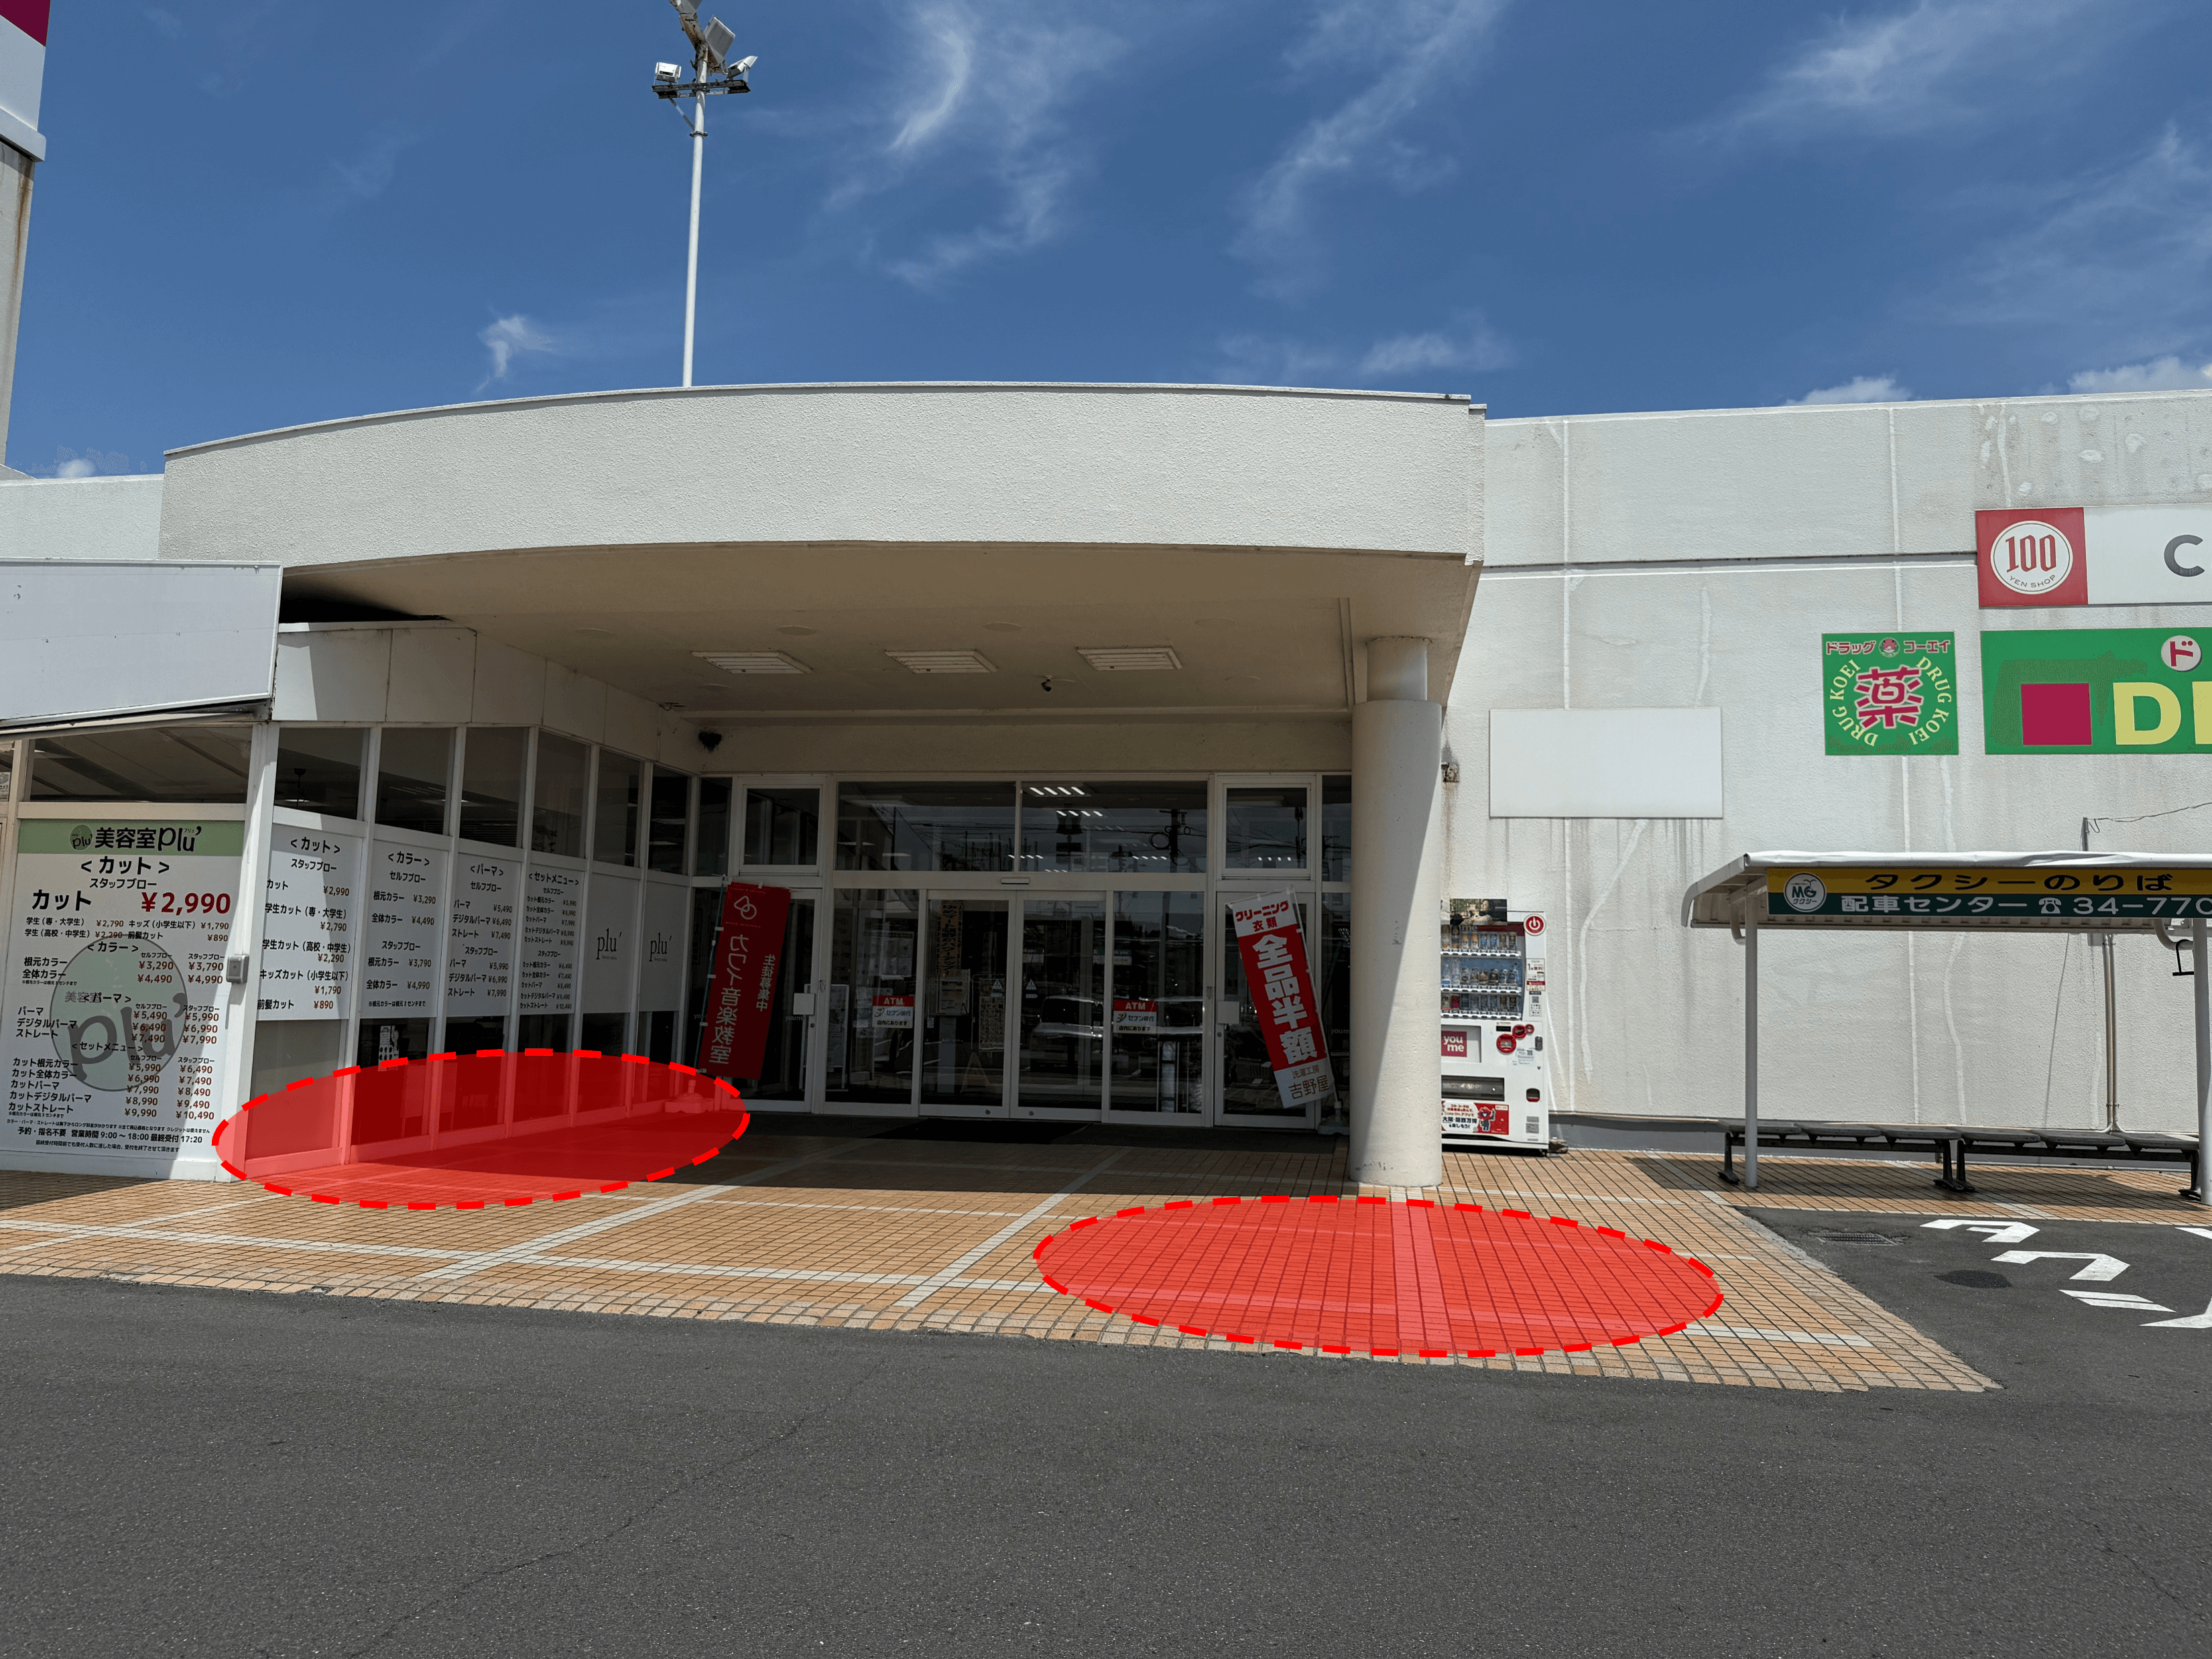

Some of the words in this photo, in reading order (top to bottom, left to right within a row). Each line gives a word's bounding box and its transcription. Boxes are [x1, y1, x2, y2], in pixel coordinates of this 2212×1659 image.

[2006, 534, 2056, 572] 100
[2164, 535, 2205, 577] C
[2010, 575, 2027, 587] YEN
[2031, 574, 2055, 588] SHOP
[1827, 641, 1876, 654] ドラッグ
[1904, 640, 1950, 653] コーエイ
[1830, 660, 1861, 700] KOEI
[1916, 656, 1952, 703] DRUG
[1854, 664, 1924, 729] 薬
[2113, 681, 2212, 745] D
[1833, 706, 1878, 746] DRUG
[1908, 709, 1949, 745] KOEI
[291, 859, 336, 872] スタッフブロー
[89, 878, 157, 889] スタッフブロー
[390, 871, 426, 883] セルフブロー
[1865, 873, 2173, 891] タクシーのりば
[267, 879, 288, 890] カット
[323, 885, 349, 896] ¥2,990
[471, 881, 501, 892] セルフブロー
[32, 889, 92, 911] カット
[141, 892, 231, 915] ¥2,990
[373, 891, 404, 902] 根元カラー
[414, 895, 436, 904] ¥3,290
[1841, 895, 2028, 913] 配車センター
[454, 900, 471, 909] パーマ
[493, 904, 512, 913] ¥5,490
[1235, 901, 1289, 922] クリーニング
[96, 920, 124, 928] ¥2,790
[201, 922, 229, 930] ¥1,790
[320, 922, 347, 931] ¥2,790
[372, 913, 403, 924] 全体カラー
[412, 916, 434, 926] ¥4,490
[452, 914, 491, 924] デジタルパーマ
[492, 917, 511, 926] ¥6,490
[1253, 917, 1278, 931] 衣類
[95, 930, 123, 939] ¥2,290
[127, 931, 164, 940] 前髪カット
[452, 929, 479, 938] ストレート
[491, 931, 511, 939] ¥7,490
[382, 941, 420, 950] スタッフブロー
[465, 946, 498, 956] スタッフブロー
[24, 957, 68, 967] 根元カラー
[139, 961, 174, 970] ¥3,290
[188, 963, 224, 971] ¥3,790
[318, 954, 344, 963] ¥2,290
[368, 957, 399, 967] 根元カラー
[409, 959, 432, 967] ¥3,790
[450, 959, 467, 968] パーマ
[489, 962, 509, 970] ¥5,990
[22, 969, 66, 979] 全体カラー
[137, 974, 172, 983] ¥4,490
[188, 975, 223, 984] ¥4,990
[448, 973, 487, 983] デジタルパーマ
[488, 976, 507, 984] ¥6,990
[315, 985, 341, 994] ¥1,790
[366, 979, 397, 989] 全体カラー
[407, 981, 430, 989] ¥4,990
[448, 987, 475, 996] ストレート
[487, 989, 507, 997] ¥7,990
[1252, 934, 1318, 1064] 全品半額
[257, 999, 294, 1010] 前髪カット
[314, 1000, 333, 1009] ¥890
[1125, 1002, 1146, 1010] ATM
[18, 1007, 44, 1016] パーマ
[134, 1011, 167, 1020] ¥5,490
[185, 1013, 219, 1022] ¥5,990
[17, 1018, 77, 1029] デジタルパーマ
[133, 1022, 166, 1032] ¥6,490
[184, 1024, 218, 1033] ¥6,990
[15, 1029, 58, 1038] ストレート
[131, 1034, 165, 1043] ¥7,490
[182, 1036, 217, 1044] ¥7,990
[1443, 1036, 1463, 1044] you
[1447, 1044, 1465, 1052] me
[13, 1058, 78, 1068] カット根元カラー
[129, 1064, 161, 1072] ¥5,990
[180, 1064, 212, 1074] ¥6,490
[12, 1068, 77, 1079] カット全体カラー
[128, 1074, 160, 1083] ¥6,990
[179, 1076, 211, 1085] ¥7,490
[11, 1080, 59, 1090] カットパーマ
[127, 1085, 159, 1095] ¥7,990
[178, 1087, 210, 1097] ¥8,490
[1288, 1075, 1330, 1099] 吉野屋
[9, 1091, 91, 1103] カットデジタルパーマ
[125, 1097, 158, 1106] ¥8,990
[177, 1099, 210, 1109] ¥9,490
[8, 1102, 74, 1113] カットストレート
[125, 1108, 157, 1117] ¥9,990
[176, 1111, 214, 1120] ¥10,490
[17, 1127, 66, 1137] 予約・指名不要
[71, 1129, 99, 1138] 営業時間
[127, 1132, 149, 1140] 18:00
[151, 1133, 179, 1143] 最終受付
[181, 1135, 202, 1144] 17:20
